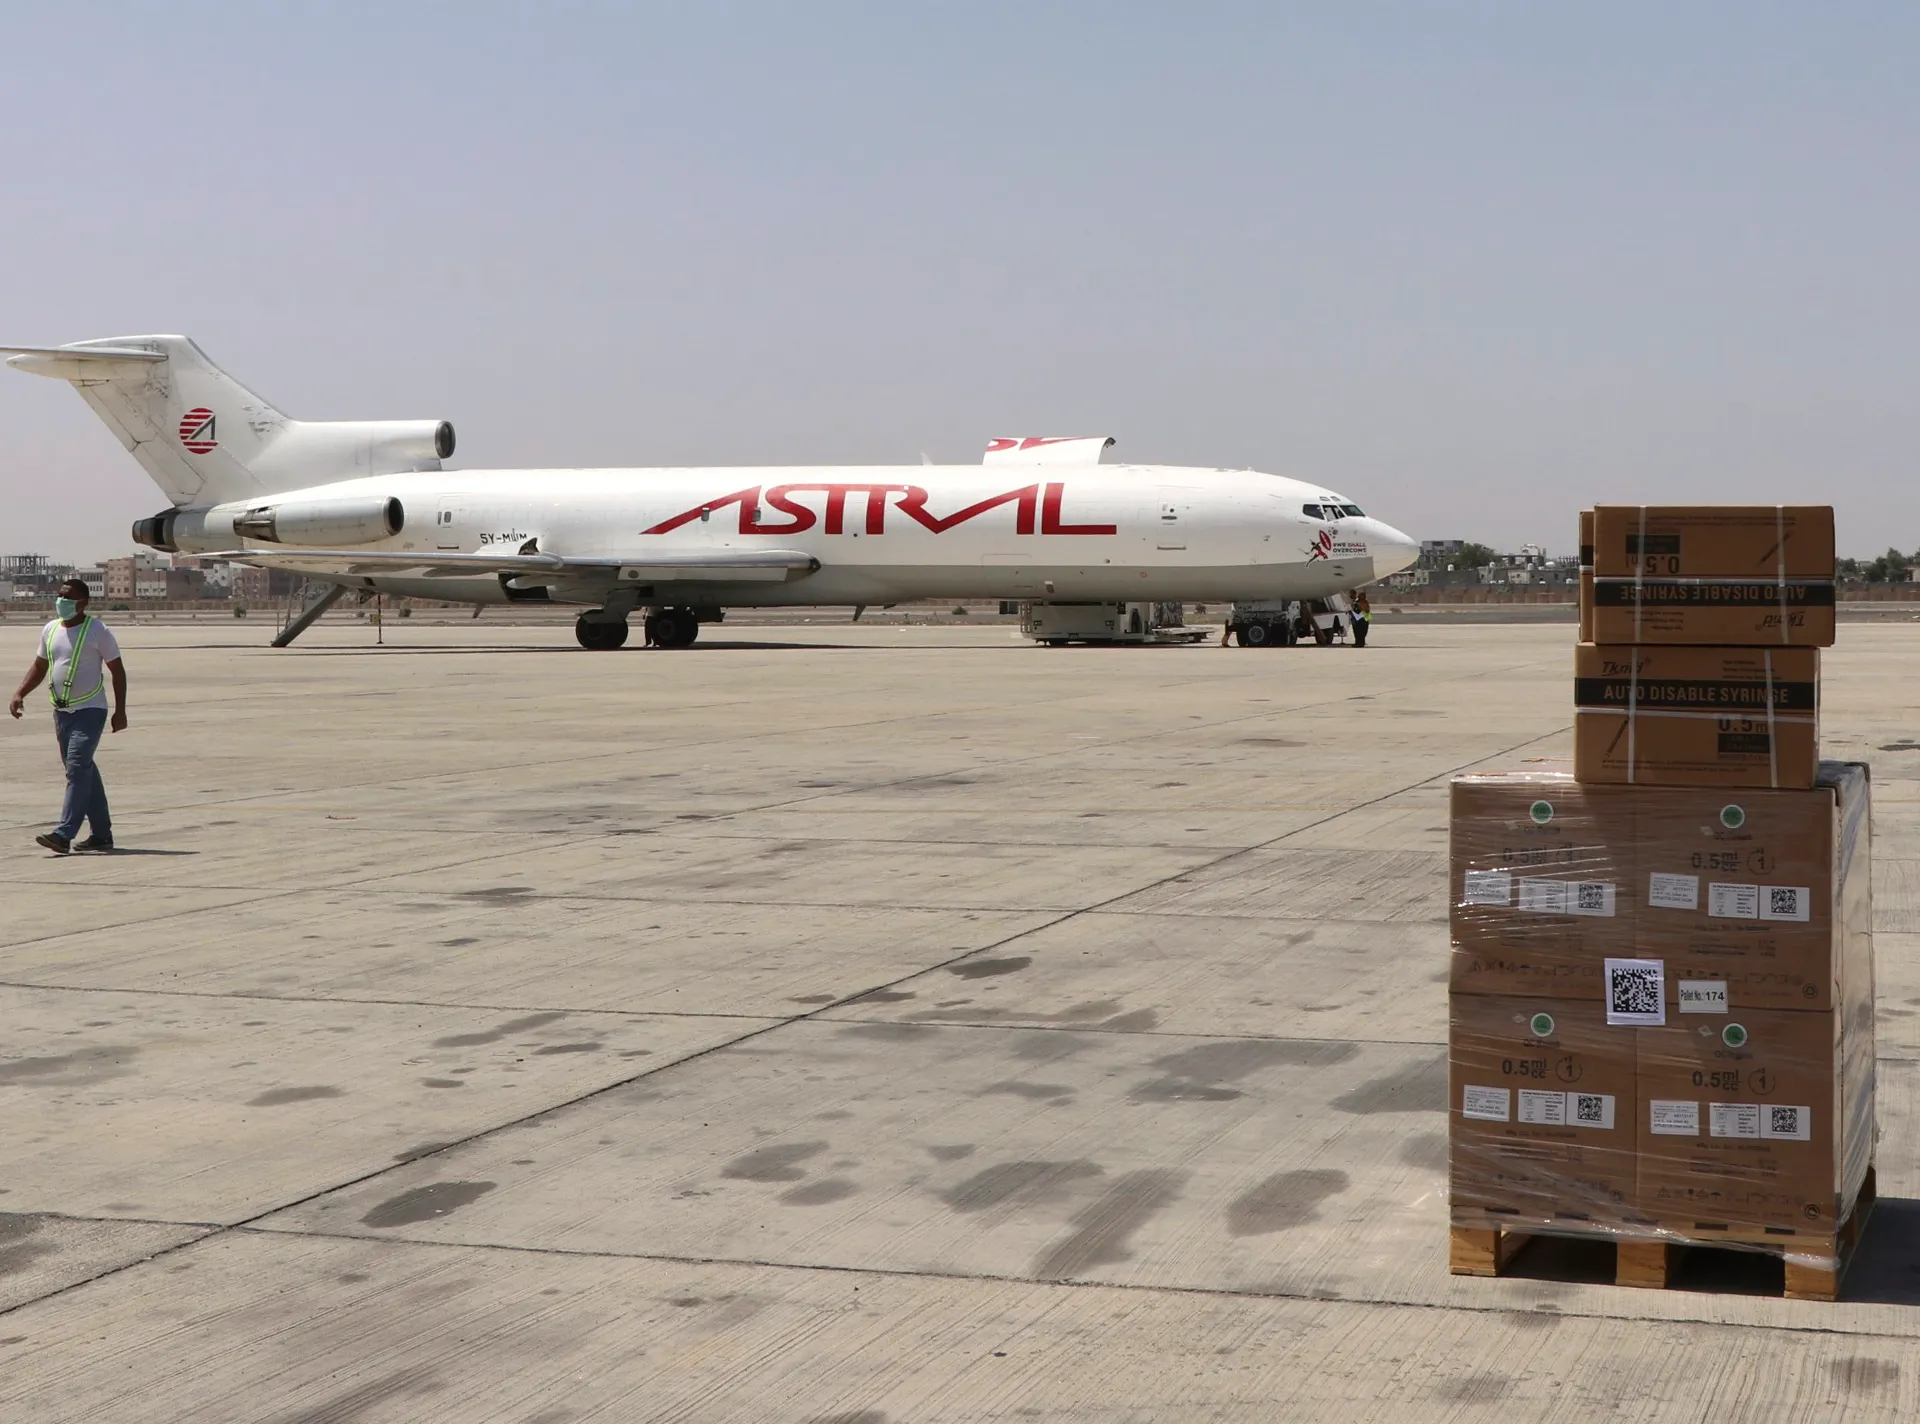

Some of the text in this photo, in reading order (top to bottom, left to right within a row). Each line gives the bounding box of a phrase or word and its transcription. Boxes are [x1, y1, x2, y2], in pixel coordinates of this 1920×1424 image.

[638, 482, 1118, 535] ASTRAL
[1645, 555, 1680, 574] 0.5
[1620, 585, 1807, 600] AUTO DISABLE SYRINGE
[1604, 685, 1789, 703] AUTO DISABLE SYRINGE
[1718, 718, 1752, 733] 0.5
[1691, 852, 1721, 869] 0.5
[1680, 989, 1694, 1001] Pallet
[1705, 991, 1725, 1002] 174
[1502, 1059, 1529, 1076] 0.5
[1531, 1058, 1547, 1068] ml
[1531, 1070, 1546, 1079] cc
[1692, 1070, 1721, 1088] 0.5
[1723, 1069, 1739, 1080] ml
[1722, 1081, 1738, 1091] cc
